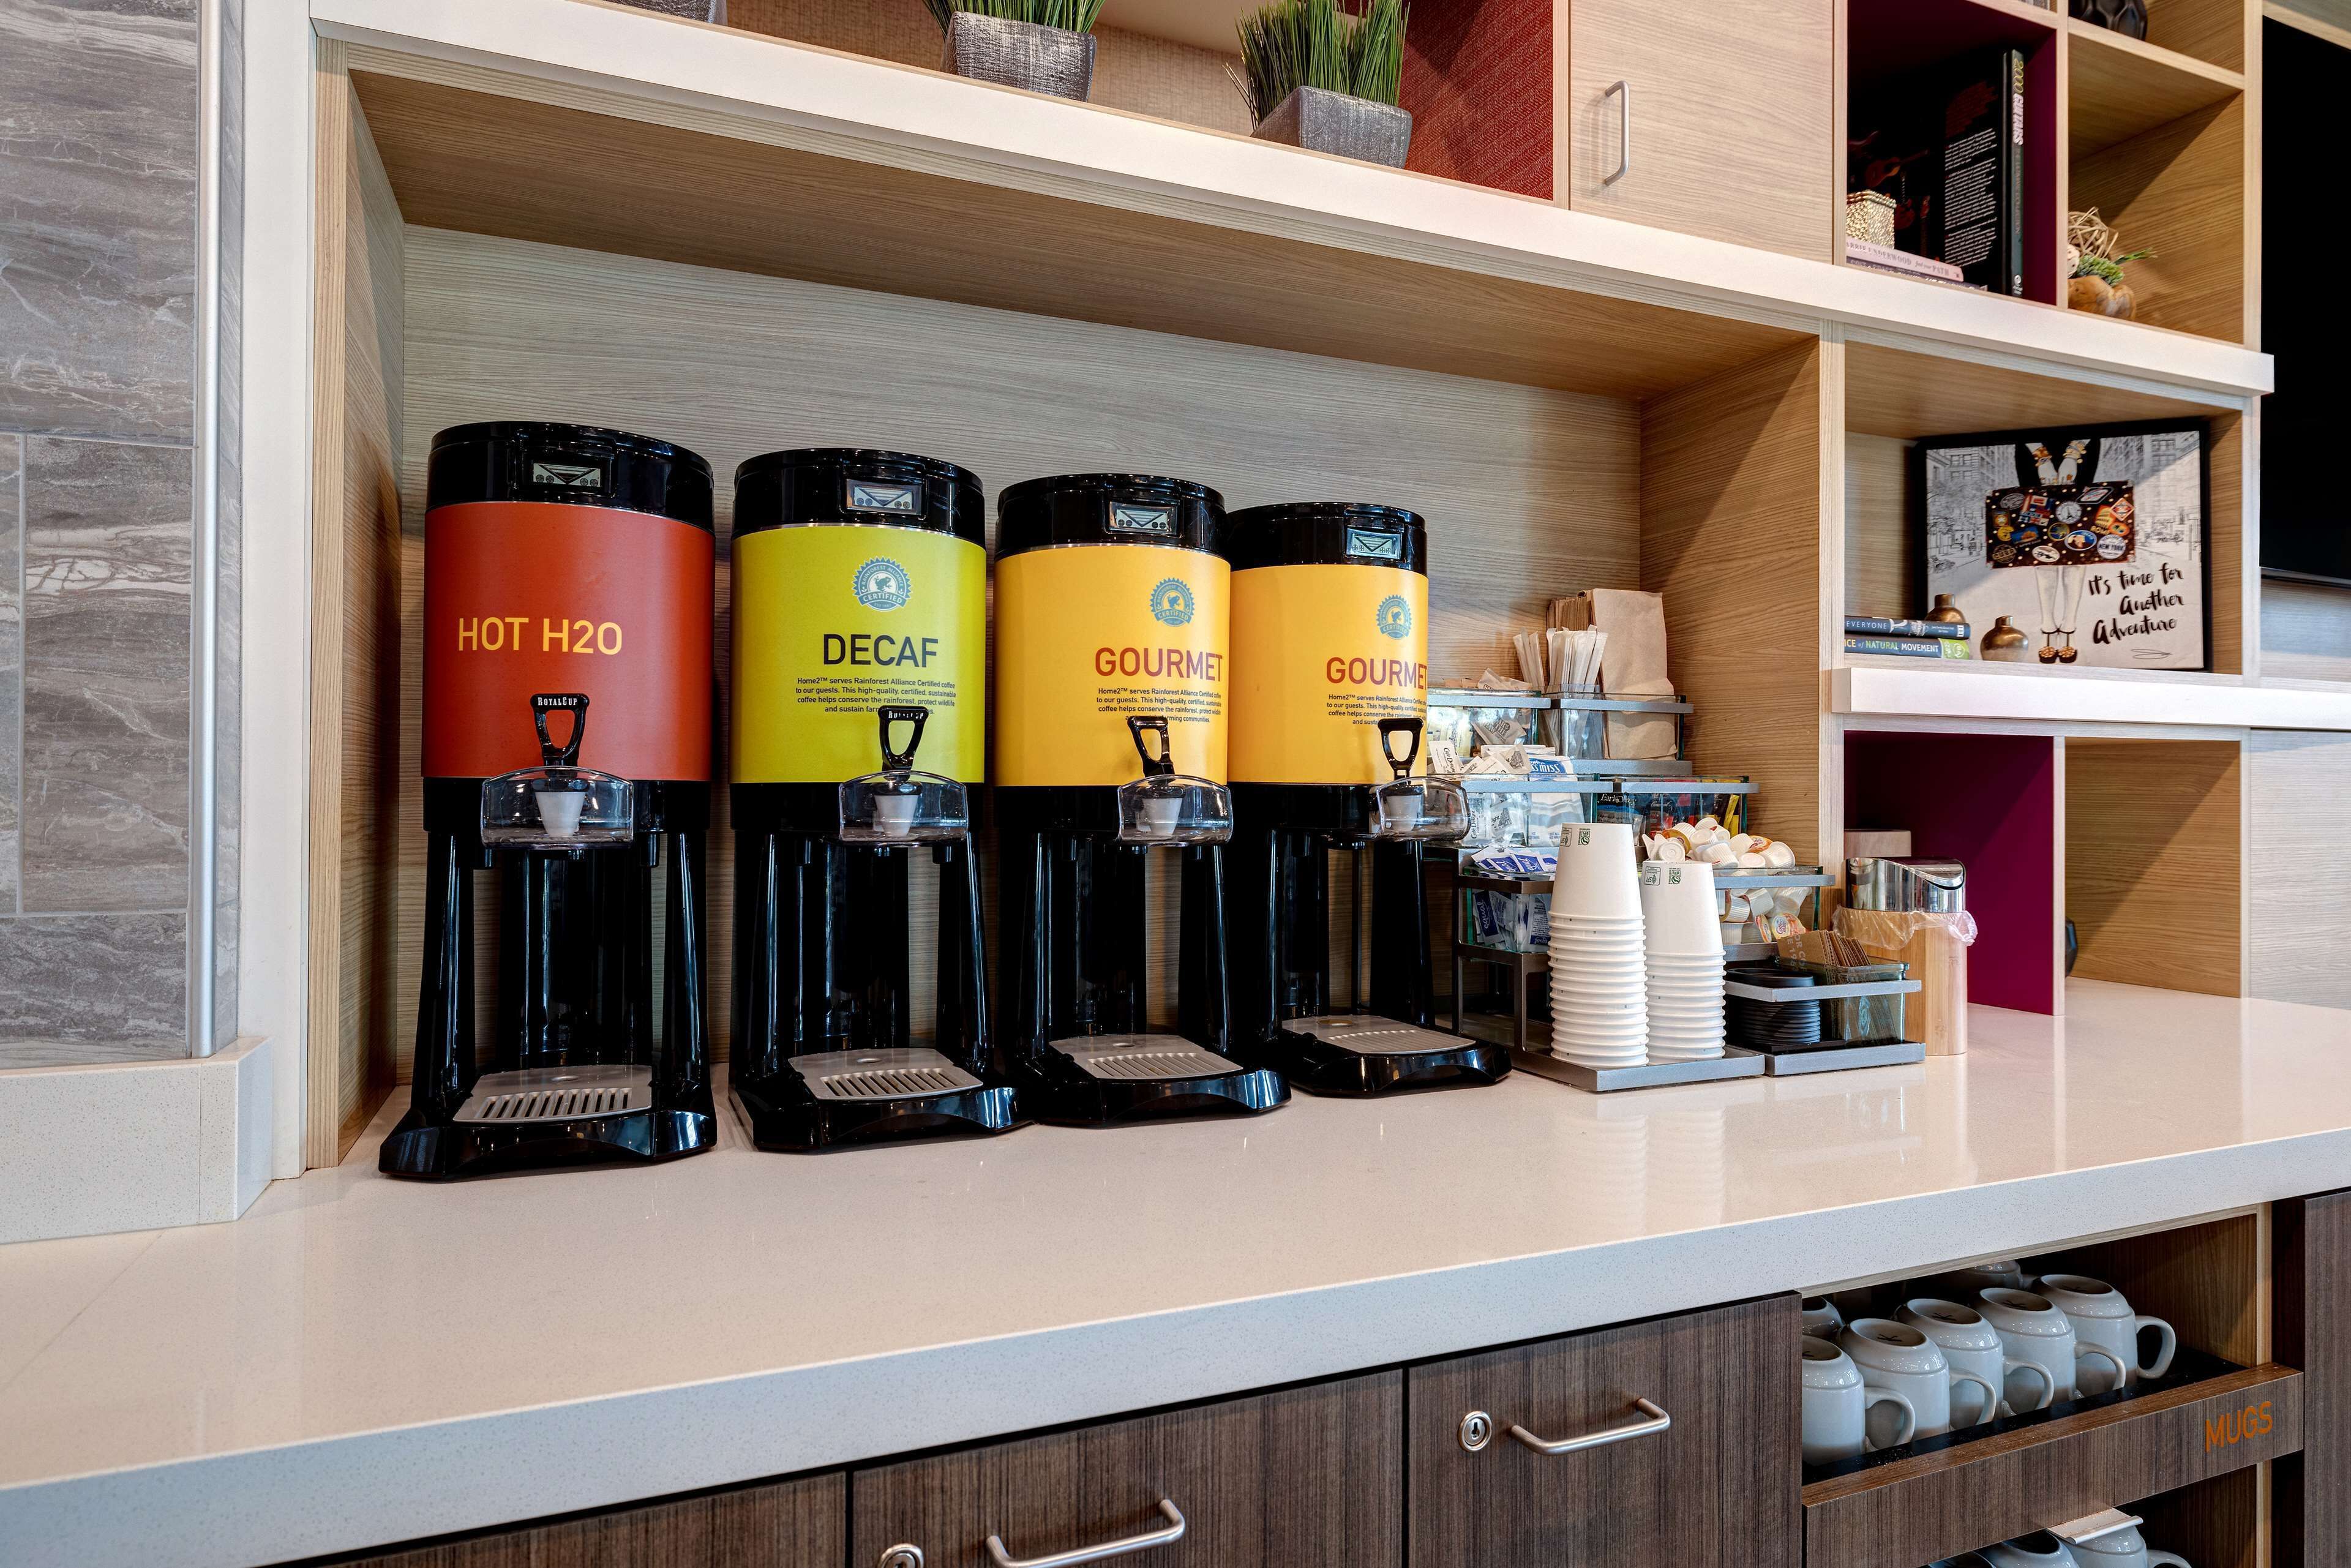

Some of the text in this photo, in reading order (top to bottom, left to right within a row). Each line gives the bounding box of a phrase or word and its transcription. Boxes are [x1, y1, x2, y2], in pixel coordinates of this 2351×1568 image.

[2013, 58, 2023, 94] 2000
[2013, 93, 2023, 146] GUITARS
[2117, 571, 2155, 590] time
[2159, 562, 2184, 585] for
[863, 593, 902, 603] CERTIFIED
[459, 617, 529, 651] HOT
[1847, 620, 1887, 629] EVERYONE
[823, 634, 939, 667] DECAF
[1865, 640, 1899, 650] NATURAL
[1901, 643, 1939, 652] MOVEMENT
[1095, 647, 1223, 682] GOURMET
[1477, 899, 1490, 929] equal
[2206, 1401, 2273, 1453] MUGS
